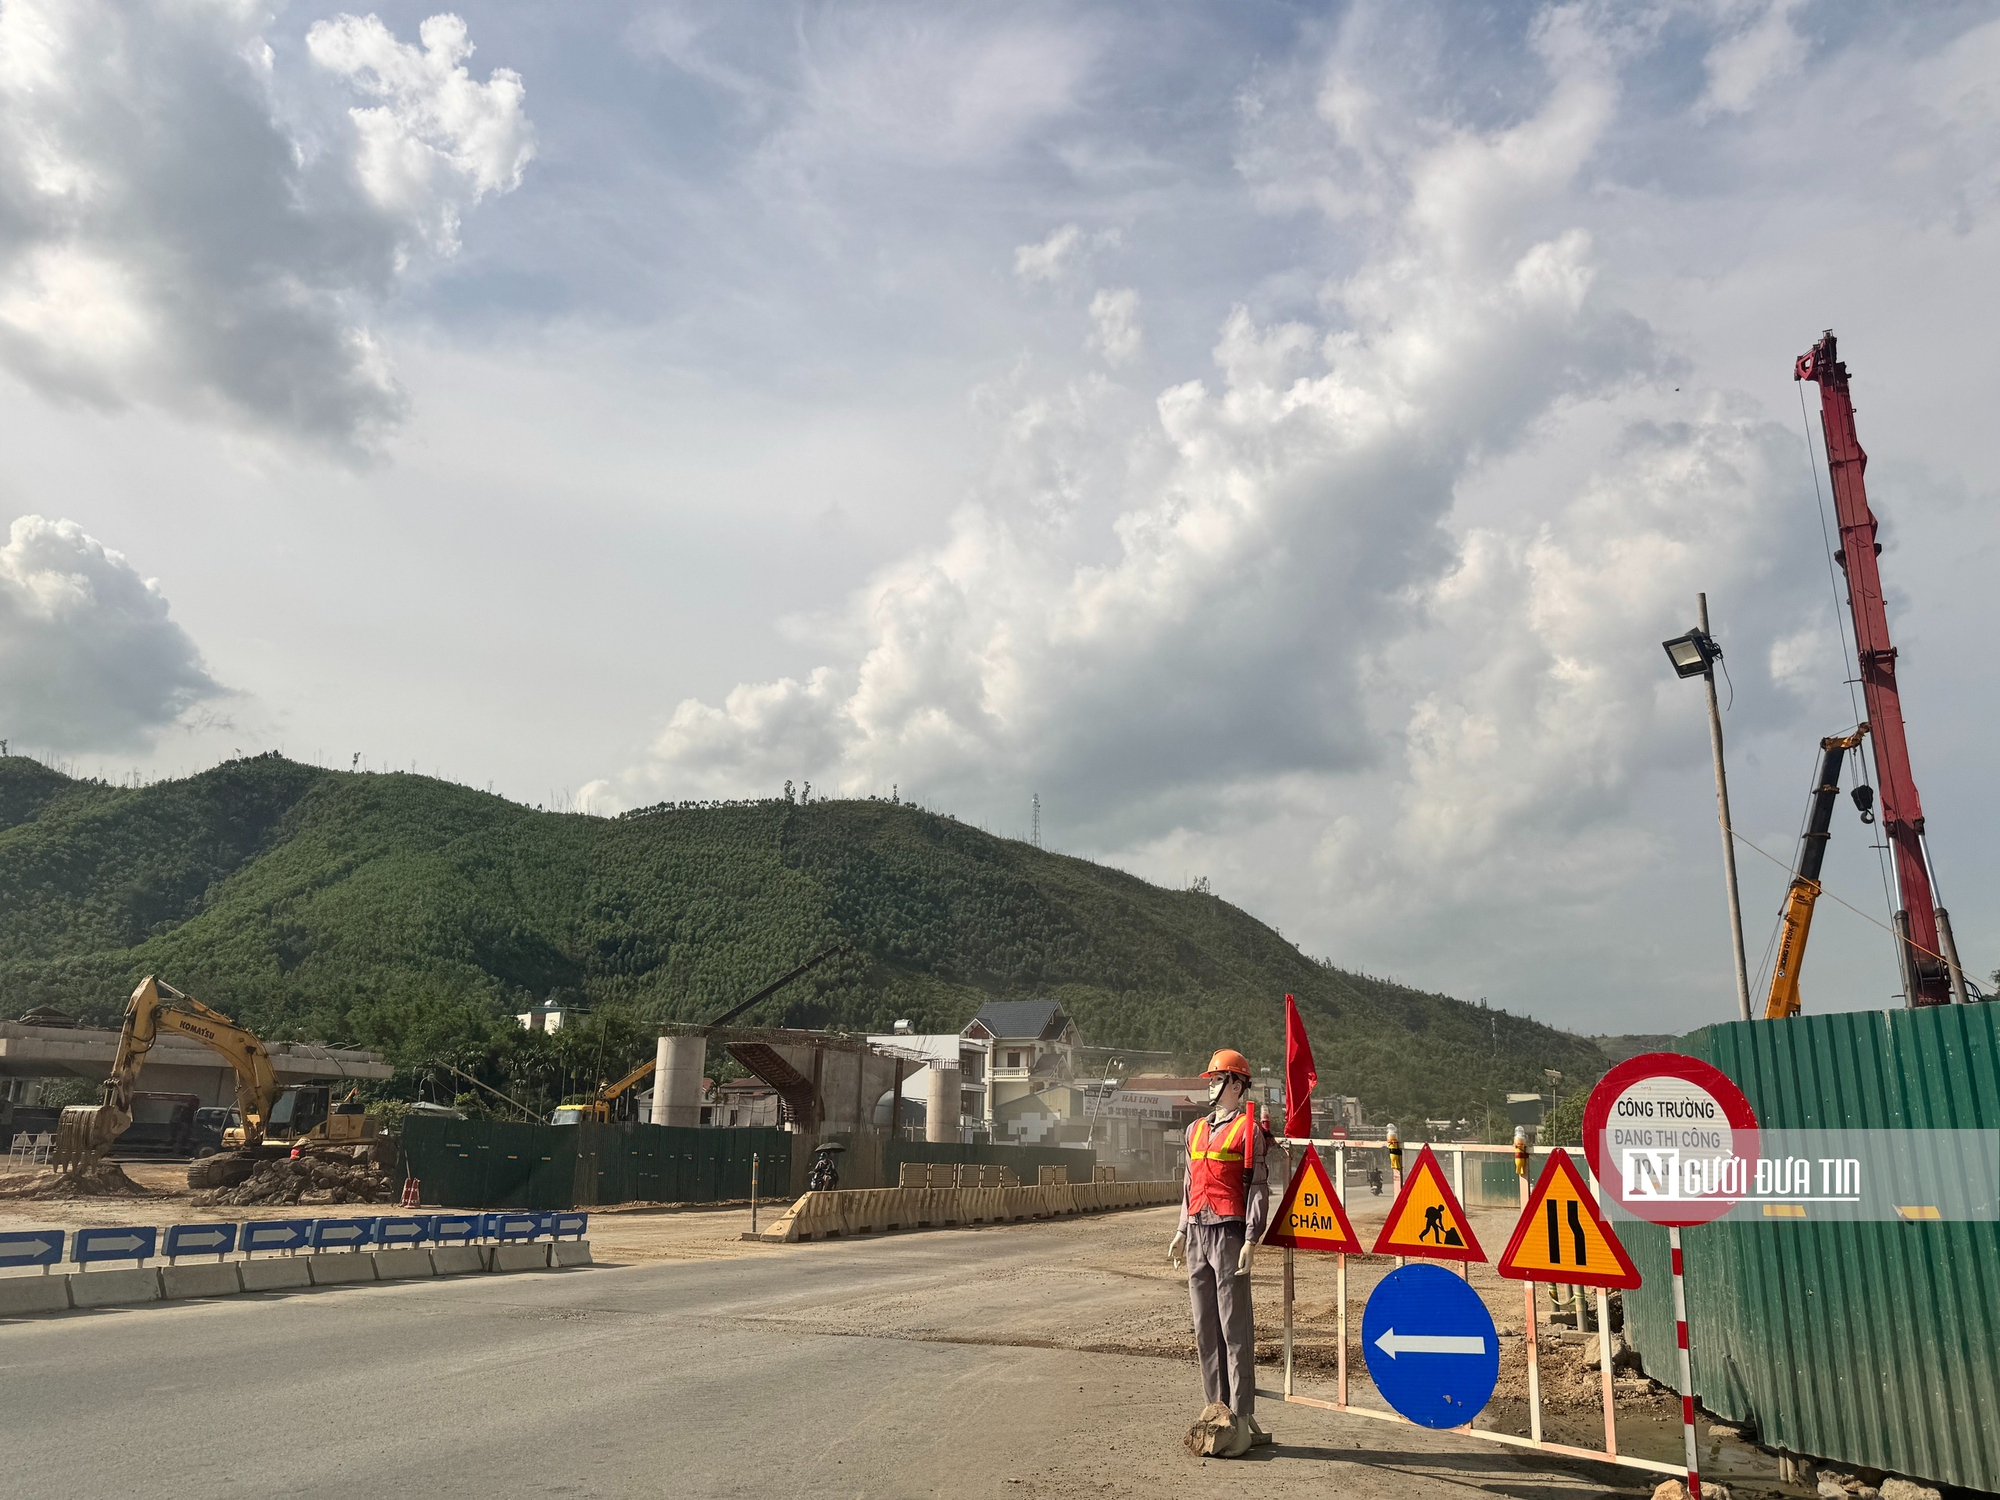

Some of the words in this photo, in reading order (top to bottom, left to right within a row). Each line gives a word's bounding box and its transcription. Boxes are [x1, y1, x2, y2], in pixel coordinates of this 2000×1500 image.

[179, 1020, 215, 1039] KOMATSU
[1138, 1096, 1159, 1104] LINH
[1617, 1097, 1653, 1117] CÔNG
[1657, 1096, 1714, 1118] TRƯỜNG
[1615, 1129, 1652, 1146] ĐANG
[1656, 1130, 1678, 1147] THI
[1682, 1127, 1720, 1148] CÔNG
[1304, 1193, 1318, 1207] ĐI
[1289, 1212, 1332, 1232] CHẬM
